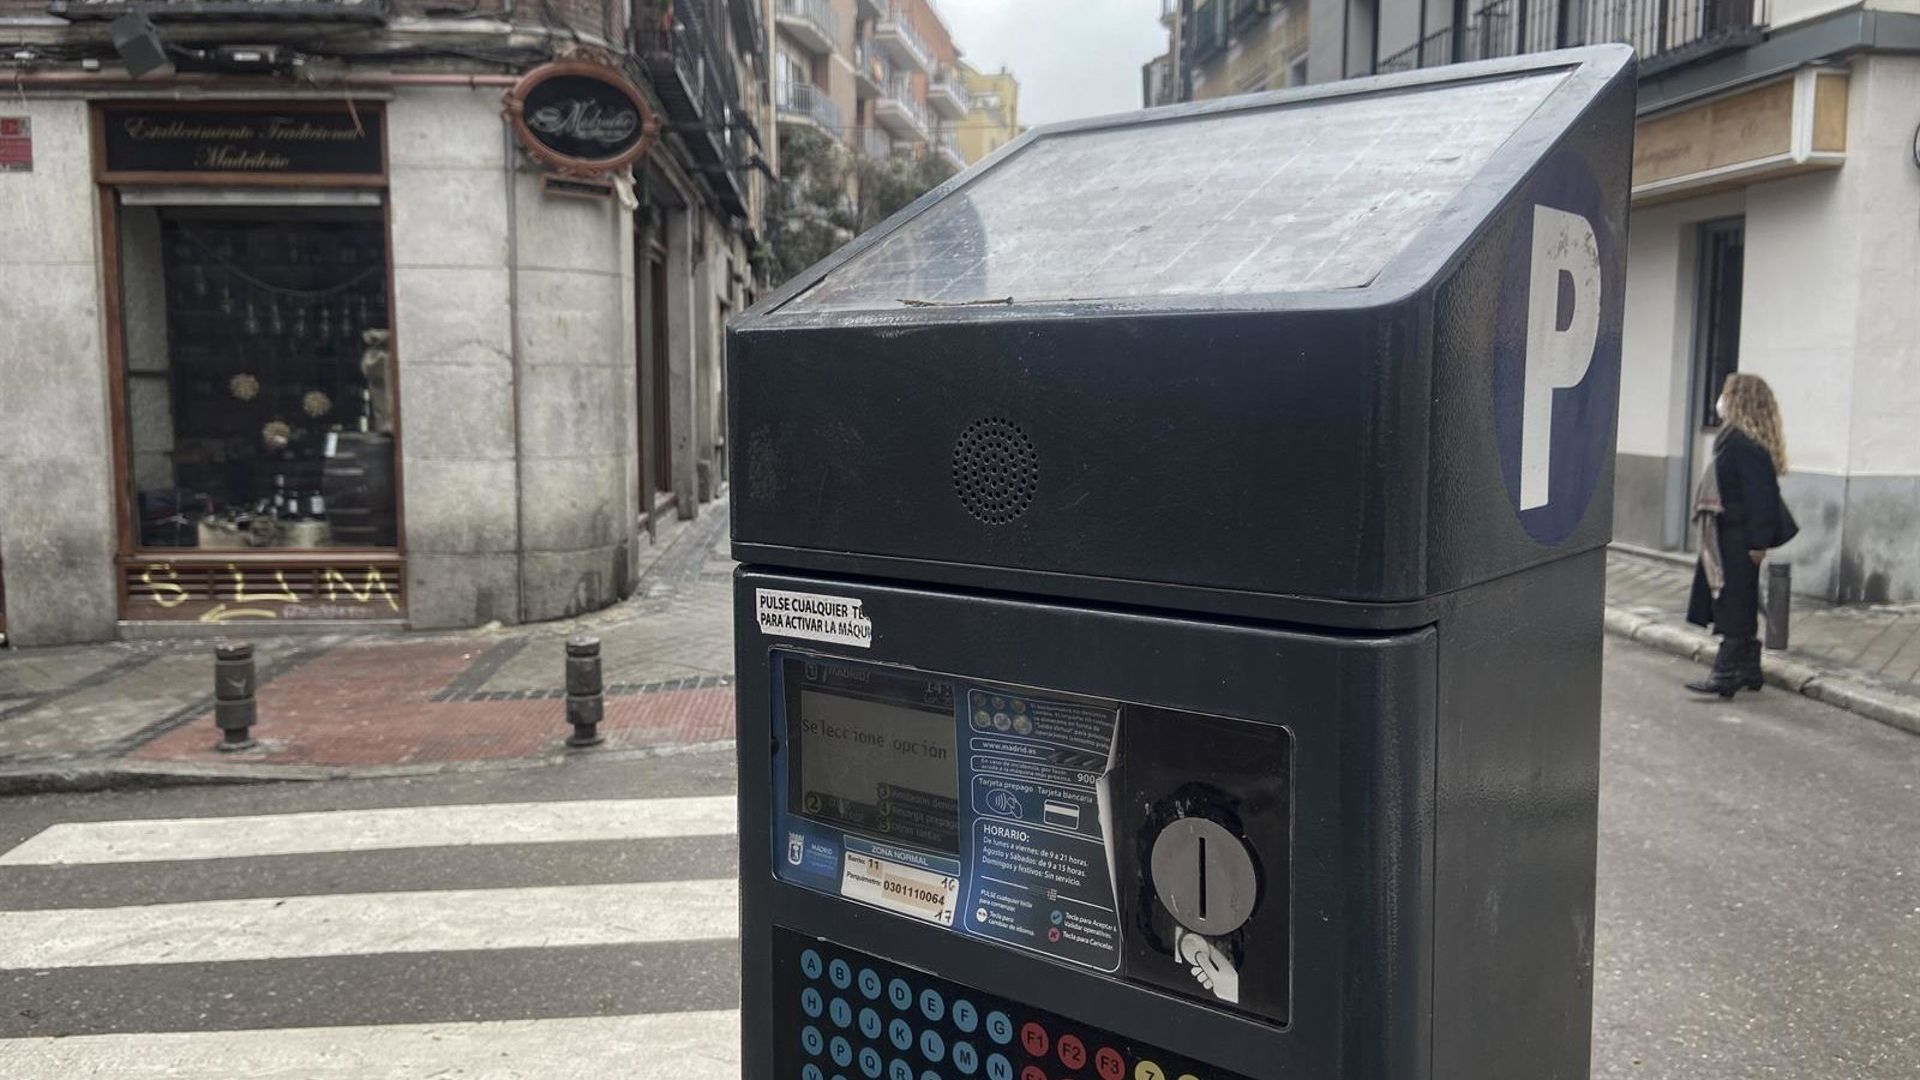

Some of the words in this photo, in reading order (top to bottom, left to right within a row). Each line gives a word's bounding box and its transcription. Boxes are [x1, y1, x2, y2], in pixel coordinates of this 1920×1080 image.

[1520, 204, 1602, 511] P
[760, 595, 790, 611] PULSE
[791, 598, 848, 617] CUALQUIER
[760, 612, 784, 628] PARA
[785, 615, 823, 632] ACTIVAR
[825, 619, 837, 634] LA
[893, 737, 947, 761] opción
[979, 777, 1003, 789] Tarjeta
[1004, 780, 1034, 794] prepago
[1038, 786, 1062, 799] Tarjeta
[1063, 789, 1093, 804] bancaria
[1076, 772, 1096, 785] 900
[983, 824, 1030, 843] HORARIO:
[869, 858, 880, 870] 11
[871, 845, 894, 859] ZONA
[895, 850, 929, 867] NORMAL
[983, 845, 1005, 858] Agosto
[1038, 858, 1047, 867] de
[1040, 849, 1049, 857] de
[982, 856, 1013, 871] Domingos
[1044, 870, 1054, 880] Sin
[883, 880, 945, 906] 0301110064
[807, 958, 816, 973] A
[836, 966, 844, 981] B
[865, 977, 874, 991] C
[896, 987, 905, 1001] D
[927, 998, 936, 1013] E
[961, 1008, 969, 1022] F
[994, 1020, 1005, 1035] G
[807, 995, 817, 1010] H
[866, 1015, 874, 1031] J
[896, 1025, 904, 1041] K
[928, 1038, 936, 1053] L
[959, 1050, 970, 1066] M
[994, 1062, 1005, 1078] N
[837, 1046, 845, 1057] P
[865, 1055, 875, 1072] Q
[896, 1067, 906, 1080] R
[1027, 1031, 1044, 1049] F1
[1062, 1043, 1081, 1062] F2
[1101, 1055, 1120, 1074] F3
